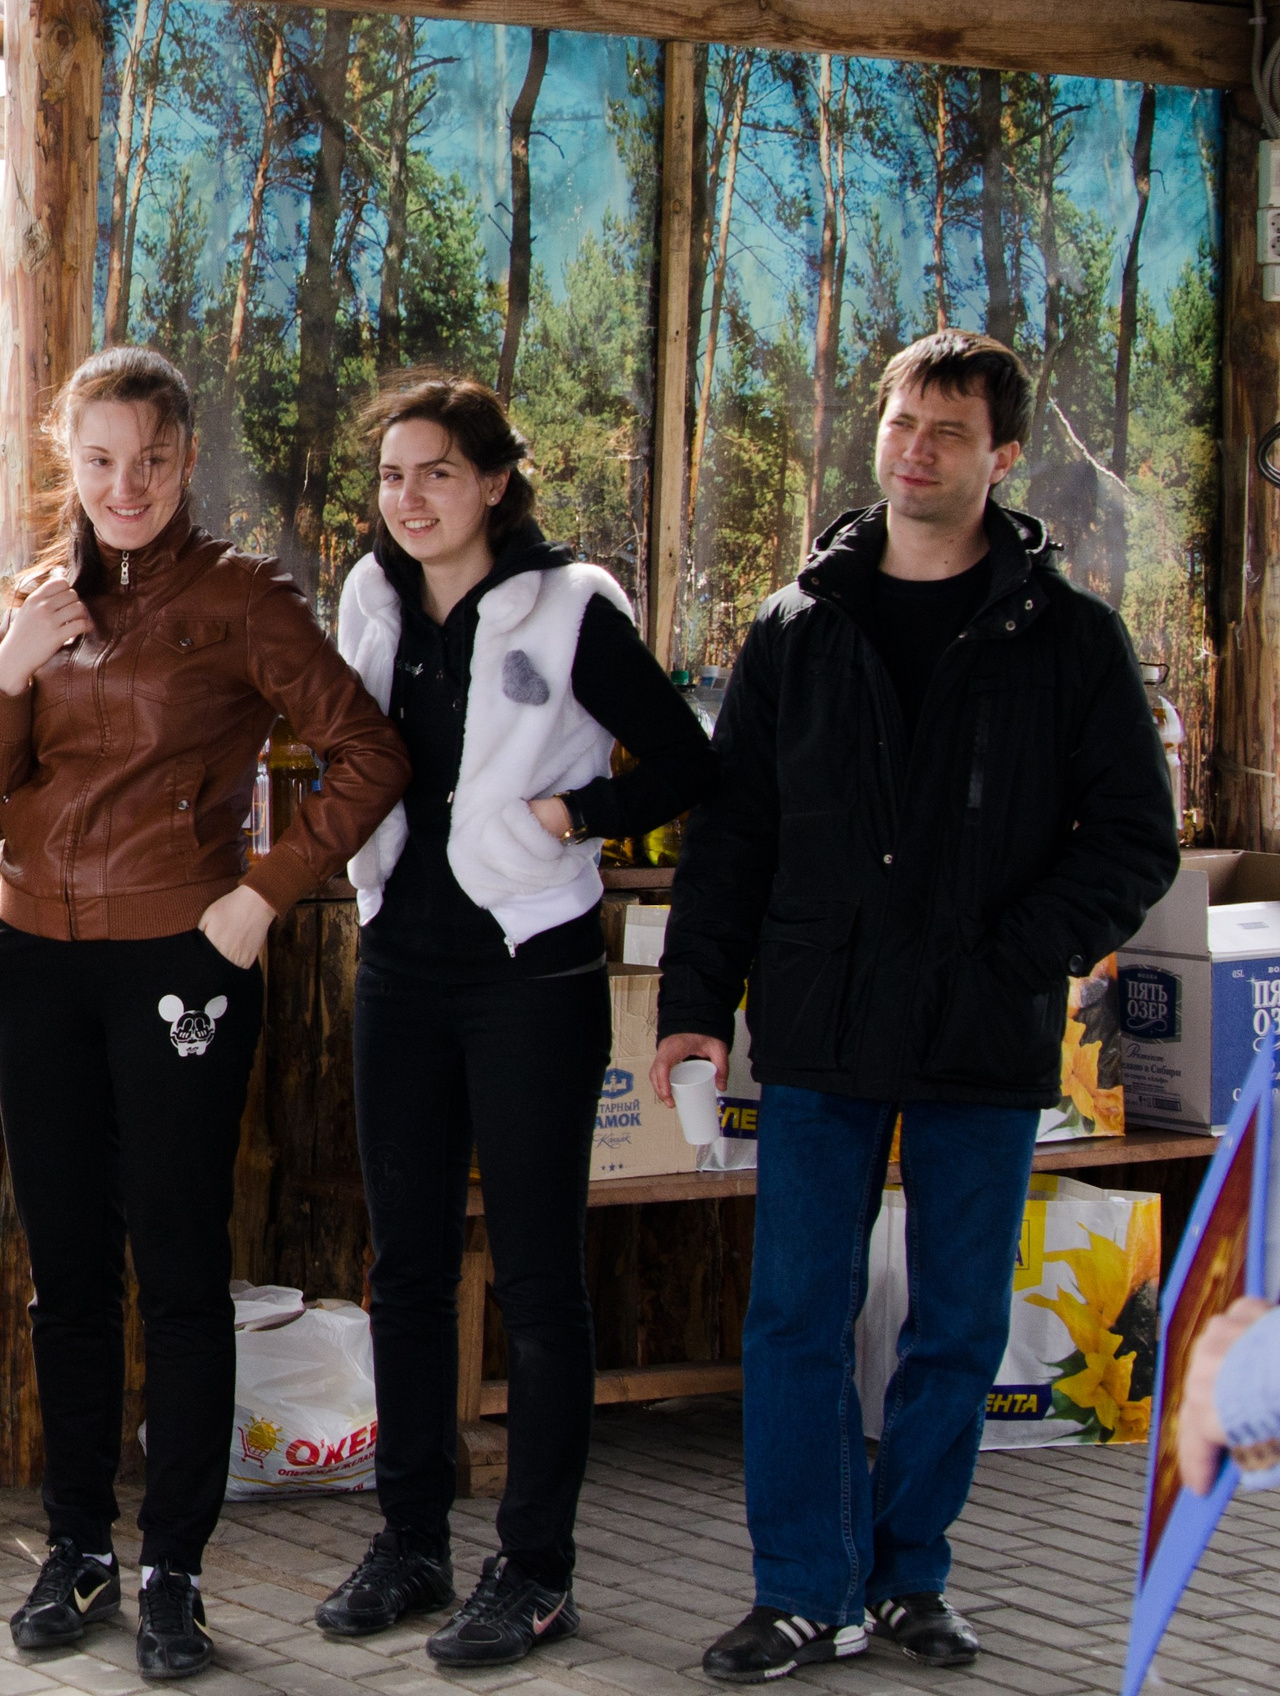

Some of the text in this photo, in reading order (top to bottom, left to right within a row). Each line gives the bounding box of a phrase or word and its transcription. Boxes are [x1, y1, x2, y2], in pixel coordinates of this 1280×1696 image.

[1128, 980, 1168, 1003] ПЯТЬ
[1253, 979, 1280, 1009] ПЯ
[1127, 999, 1168, 1020] ОЗЕР
[1253, 1008, 1280, 1037] ОЗ
[599, 1099, 641, 1113] ТАРНЫЙ
[595, 1113, 642, 1129] АМОК
[985, 1394, 1038, 1413] ЕНТА
[340, 1451, 376, 1471] ЖЕЛАН
